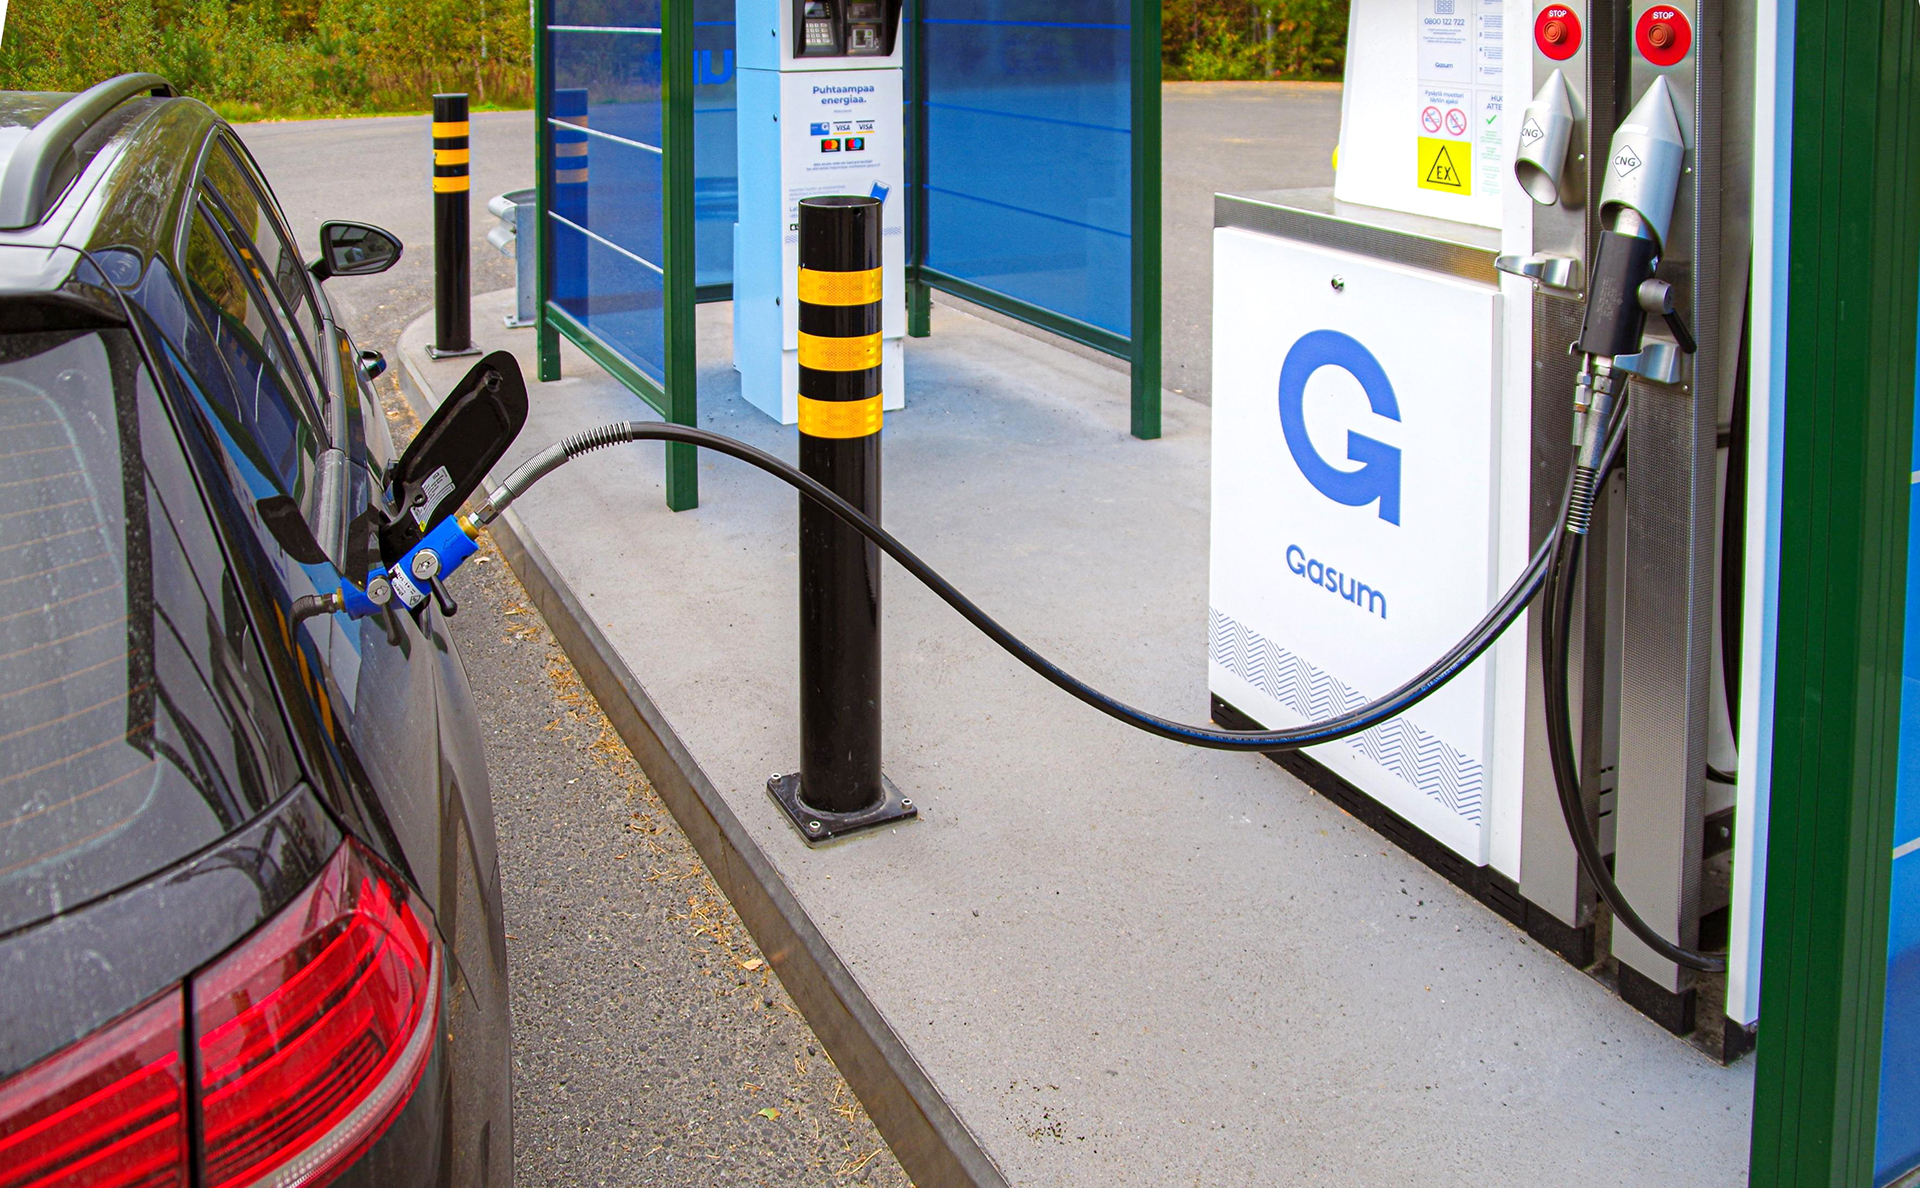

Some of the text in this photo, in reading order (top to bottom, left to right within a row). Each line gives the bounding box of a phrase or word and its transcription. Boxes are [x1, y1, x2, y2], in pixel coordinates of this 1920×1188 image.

[1653, 11, 1674, 19] STOP
[1442, 18, 1452, 26] 122
[1453, 18, 1465, 26] 722
[1435, 61, 1453, 69] Gasum
[812, 85, 875, 95] Puhtaampaa
[821, 95, 867, 105] energiaa.
[1520, 127, 1538, 138] CNG
[1614, 155, 1636, 167] CNG
[1436, 165, 1451, 181] EX
[1286, 544, 1387, 620] Gasum
